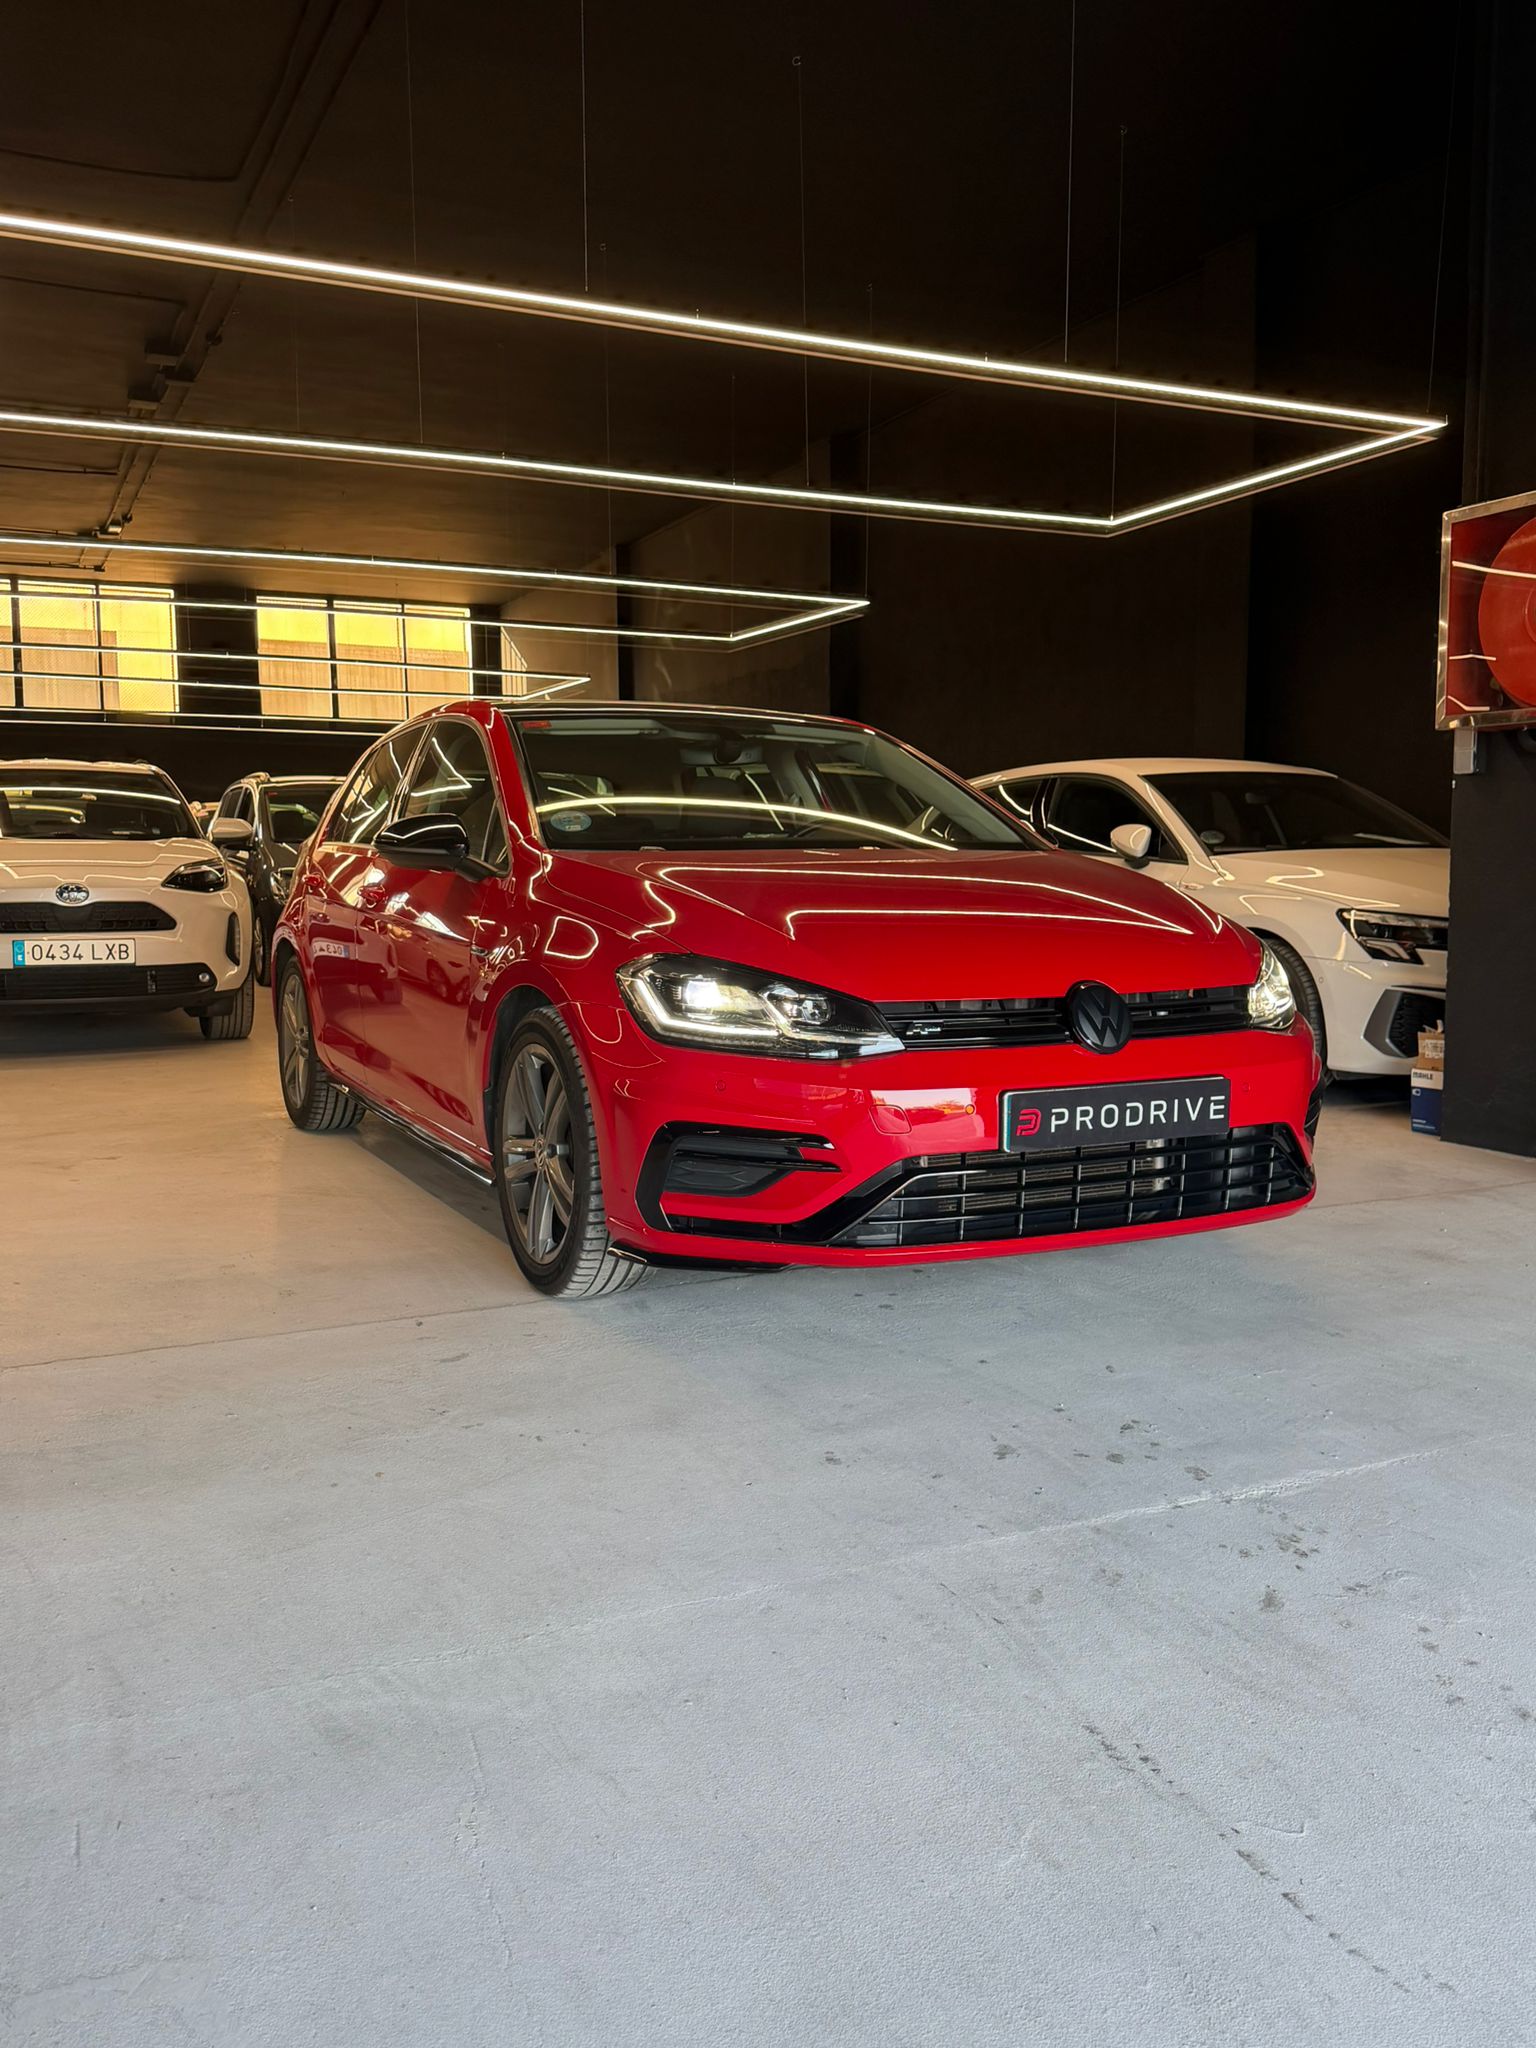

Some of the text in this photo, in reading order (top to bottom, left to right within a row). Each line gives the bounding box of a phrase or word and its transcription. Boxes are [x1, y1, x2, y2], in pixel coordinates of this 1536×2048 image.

[31, 943, 130, 960] 0434 LXB
[1050, 1095, 1226, 1133] PRODRIVE
